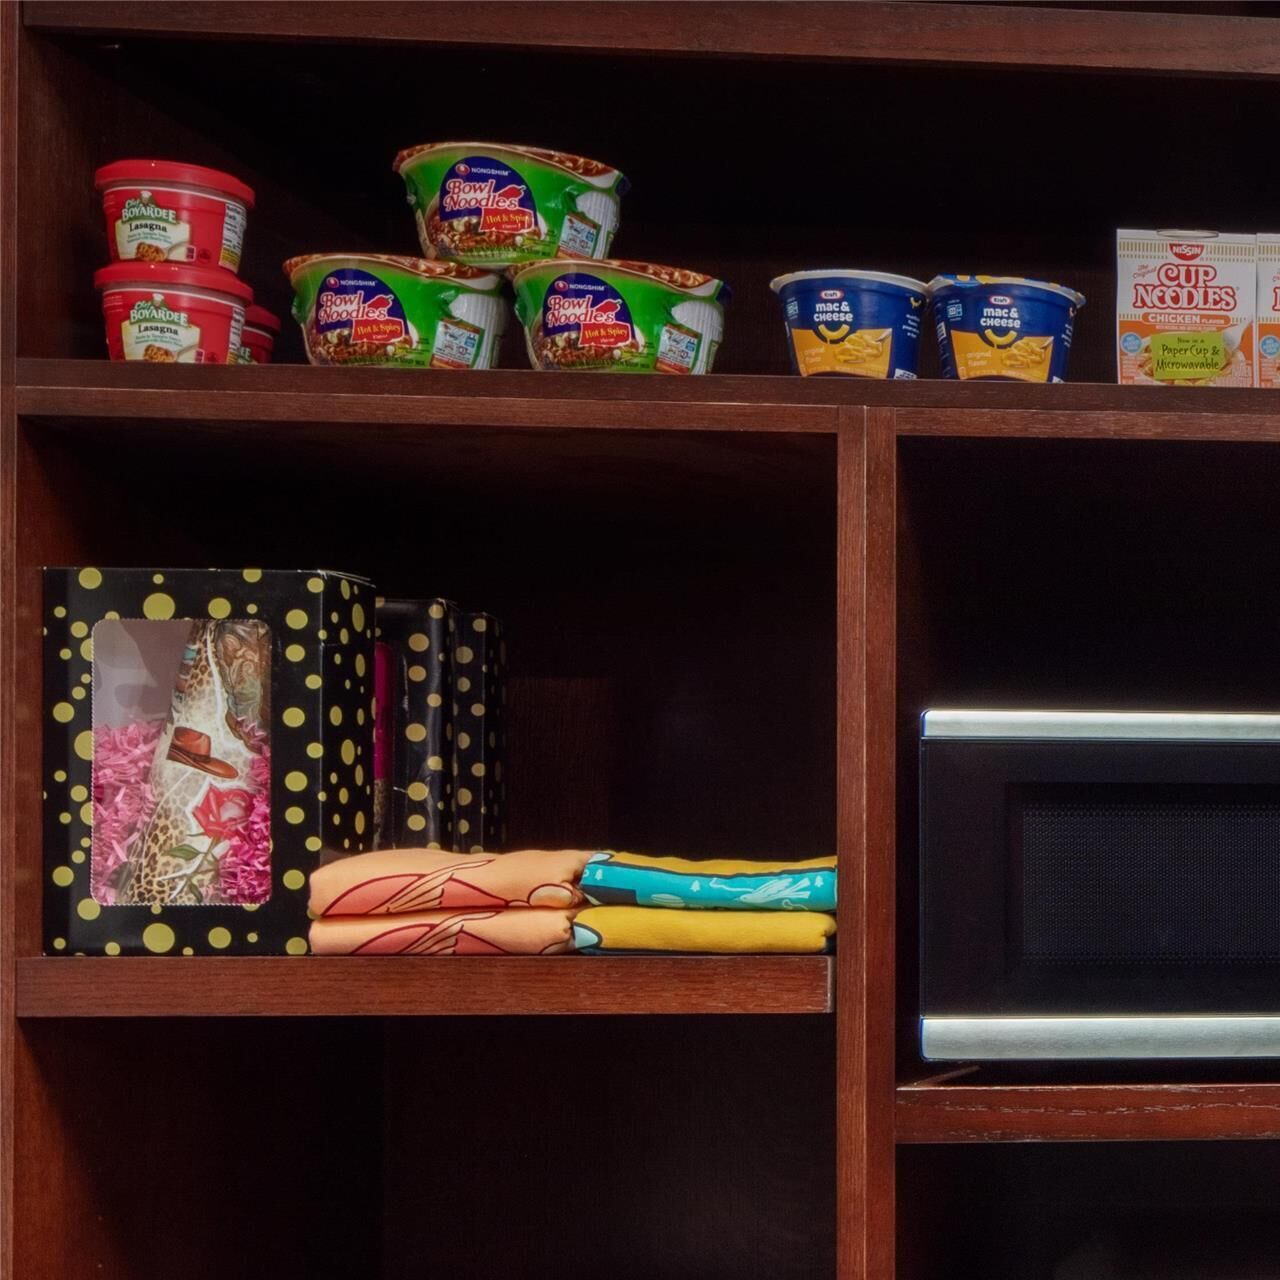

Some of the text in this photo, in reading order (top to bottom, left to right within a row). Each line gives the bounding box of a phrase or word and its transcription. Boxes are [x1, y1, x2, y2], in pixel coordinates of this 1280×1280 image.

[472, 167, 509, 176] NONGSHIM
[446, 179, 495, 194] Bowl
[443, 195, 519, 211] Noodles
[122, 207, 176, 222] BOYARDEE
[129, 222, 168, 233] Lasagna
[1172, 245, 1201, 256] NISSIN
[1158, 263, 1217, 287] CUP
[321, 291, 364, 307] Bowl
[548, 295, 592, 310] Bowl
[1132, 284, 1237, 311] NOODLES
[816, 302, 850, 312] mac &
[983, 308, 1019, 318] mac &
[130, 309, 188, 326] BOYARDEE
[319, 308, 387, 324] Noodles
[546, 311, 615, 327] Noodles
[1148, 314, 1200, 324] CHICKEN
[139, 325, 179, 335] Lasagna
[1162, 344, 1220, 356] Paper Cup &
[1155, 359, 1219, 372] Microwavable
